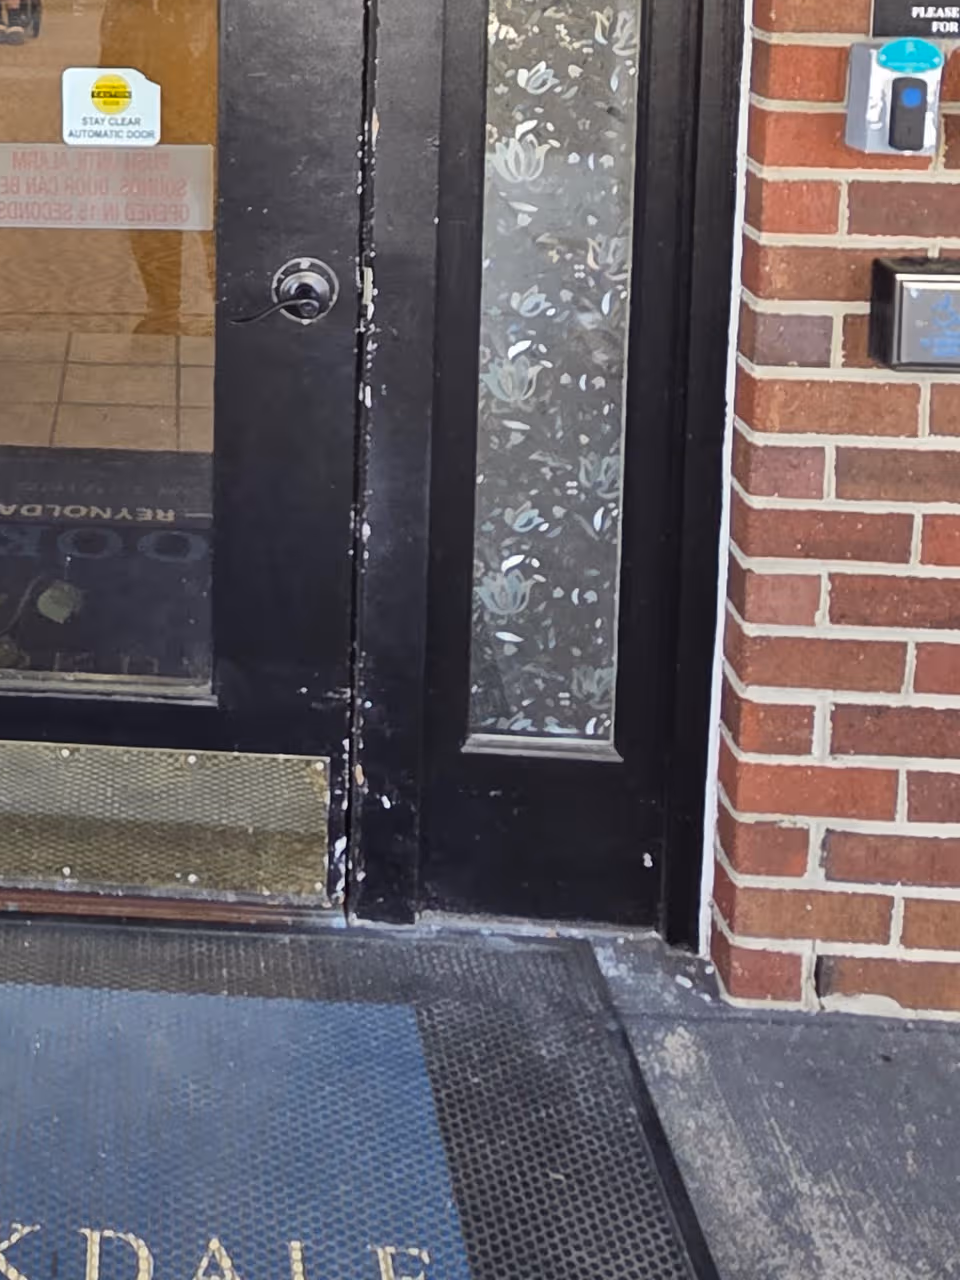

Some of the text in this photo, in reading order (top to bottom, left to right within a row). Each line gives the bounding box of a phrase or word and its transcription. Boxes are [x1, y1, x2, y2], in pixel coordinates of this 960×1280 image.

[911, 6, 960, 18] PLEASE
[932, 21, 959, 32] FOR
[81, 116, 141, 126] STAY CLEAR
[68, 130, 155, 139] AUTOMATIC DOOR
